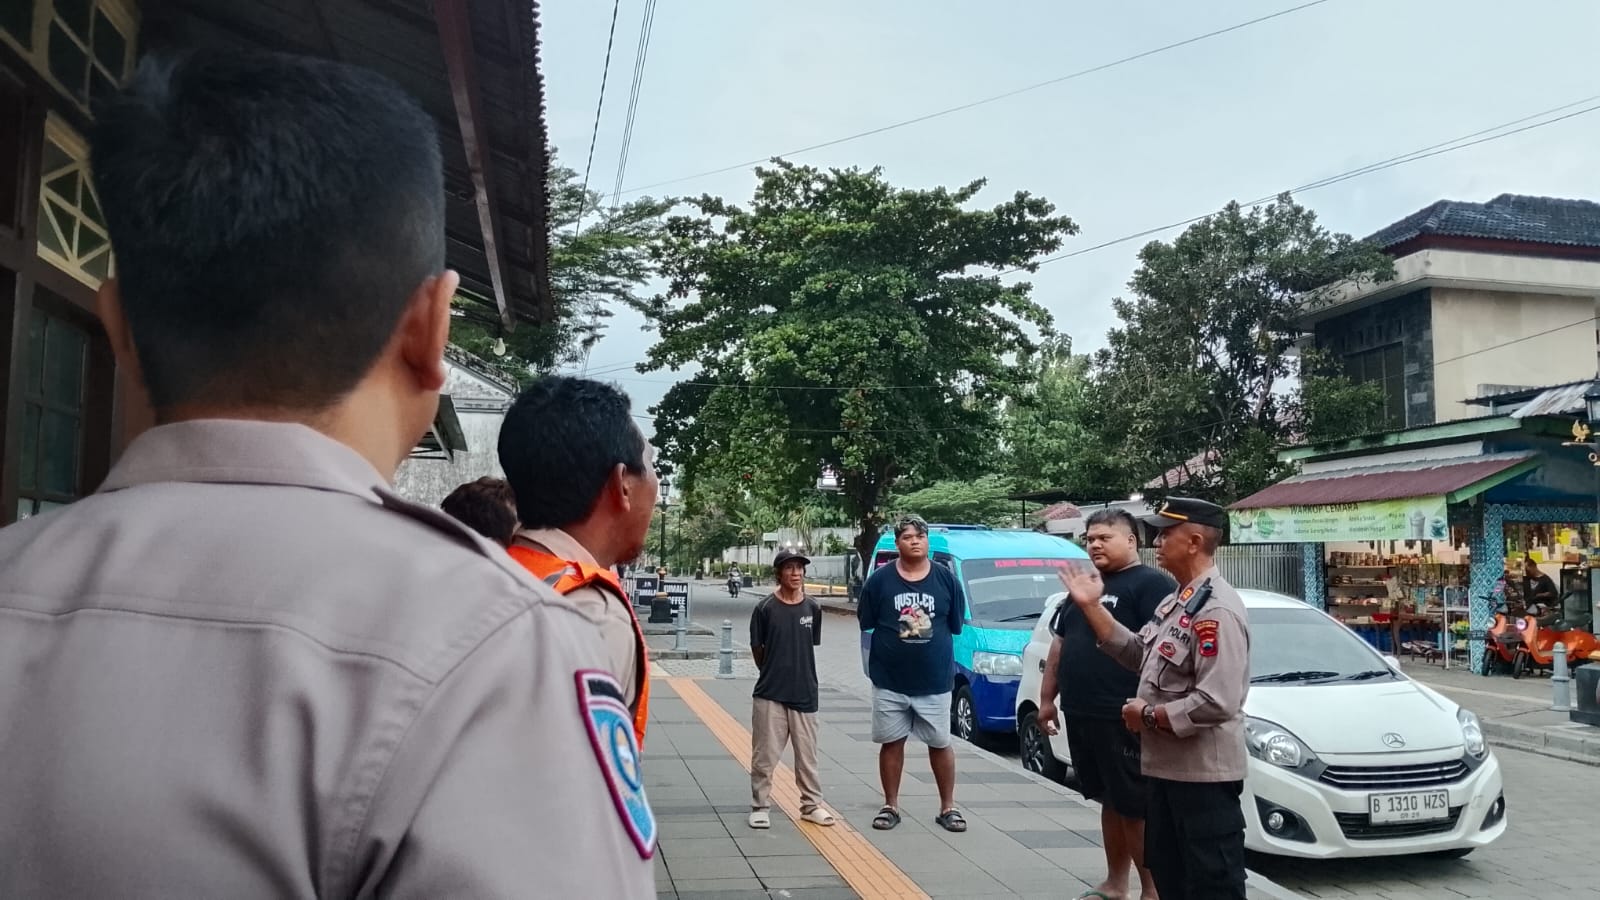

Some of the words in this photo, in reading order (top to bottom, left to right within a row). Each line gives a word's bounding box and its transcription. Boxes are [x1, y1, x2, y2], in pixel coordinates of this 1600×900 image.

[1325, 503, 1359, 513] CEMARA
[664, 584, 688, 593] UMALA
[894, 592, 935, 611] HUSTLER
[1373, 798, 1380, 813] B
[1388, 796, 1418, 812] 1310
[1424, 793, 1446, 809] WZS
